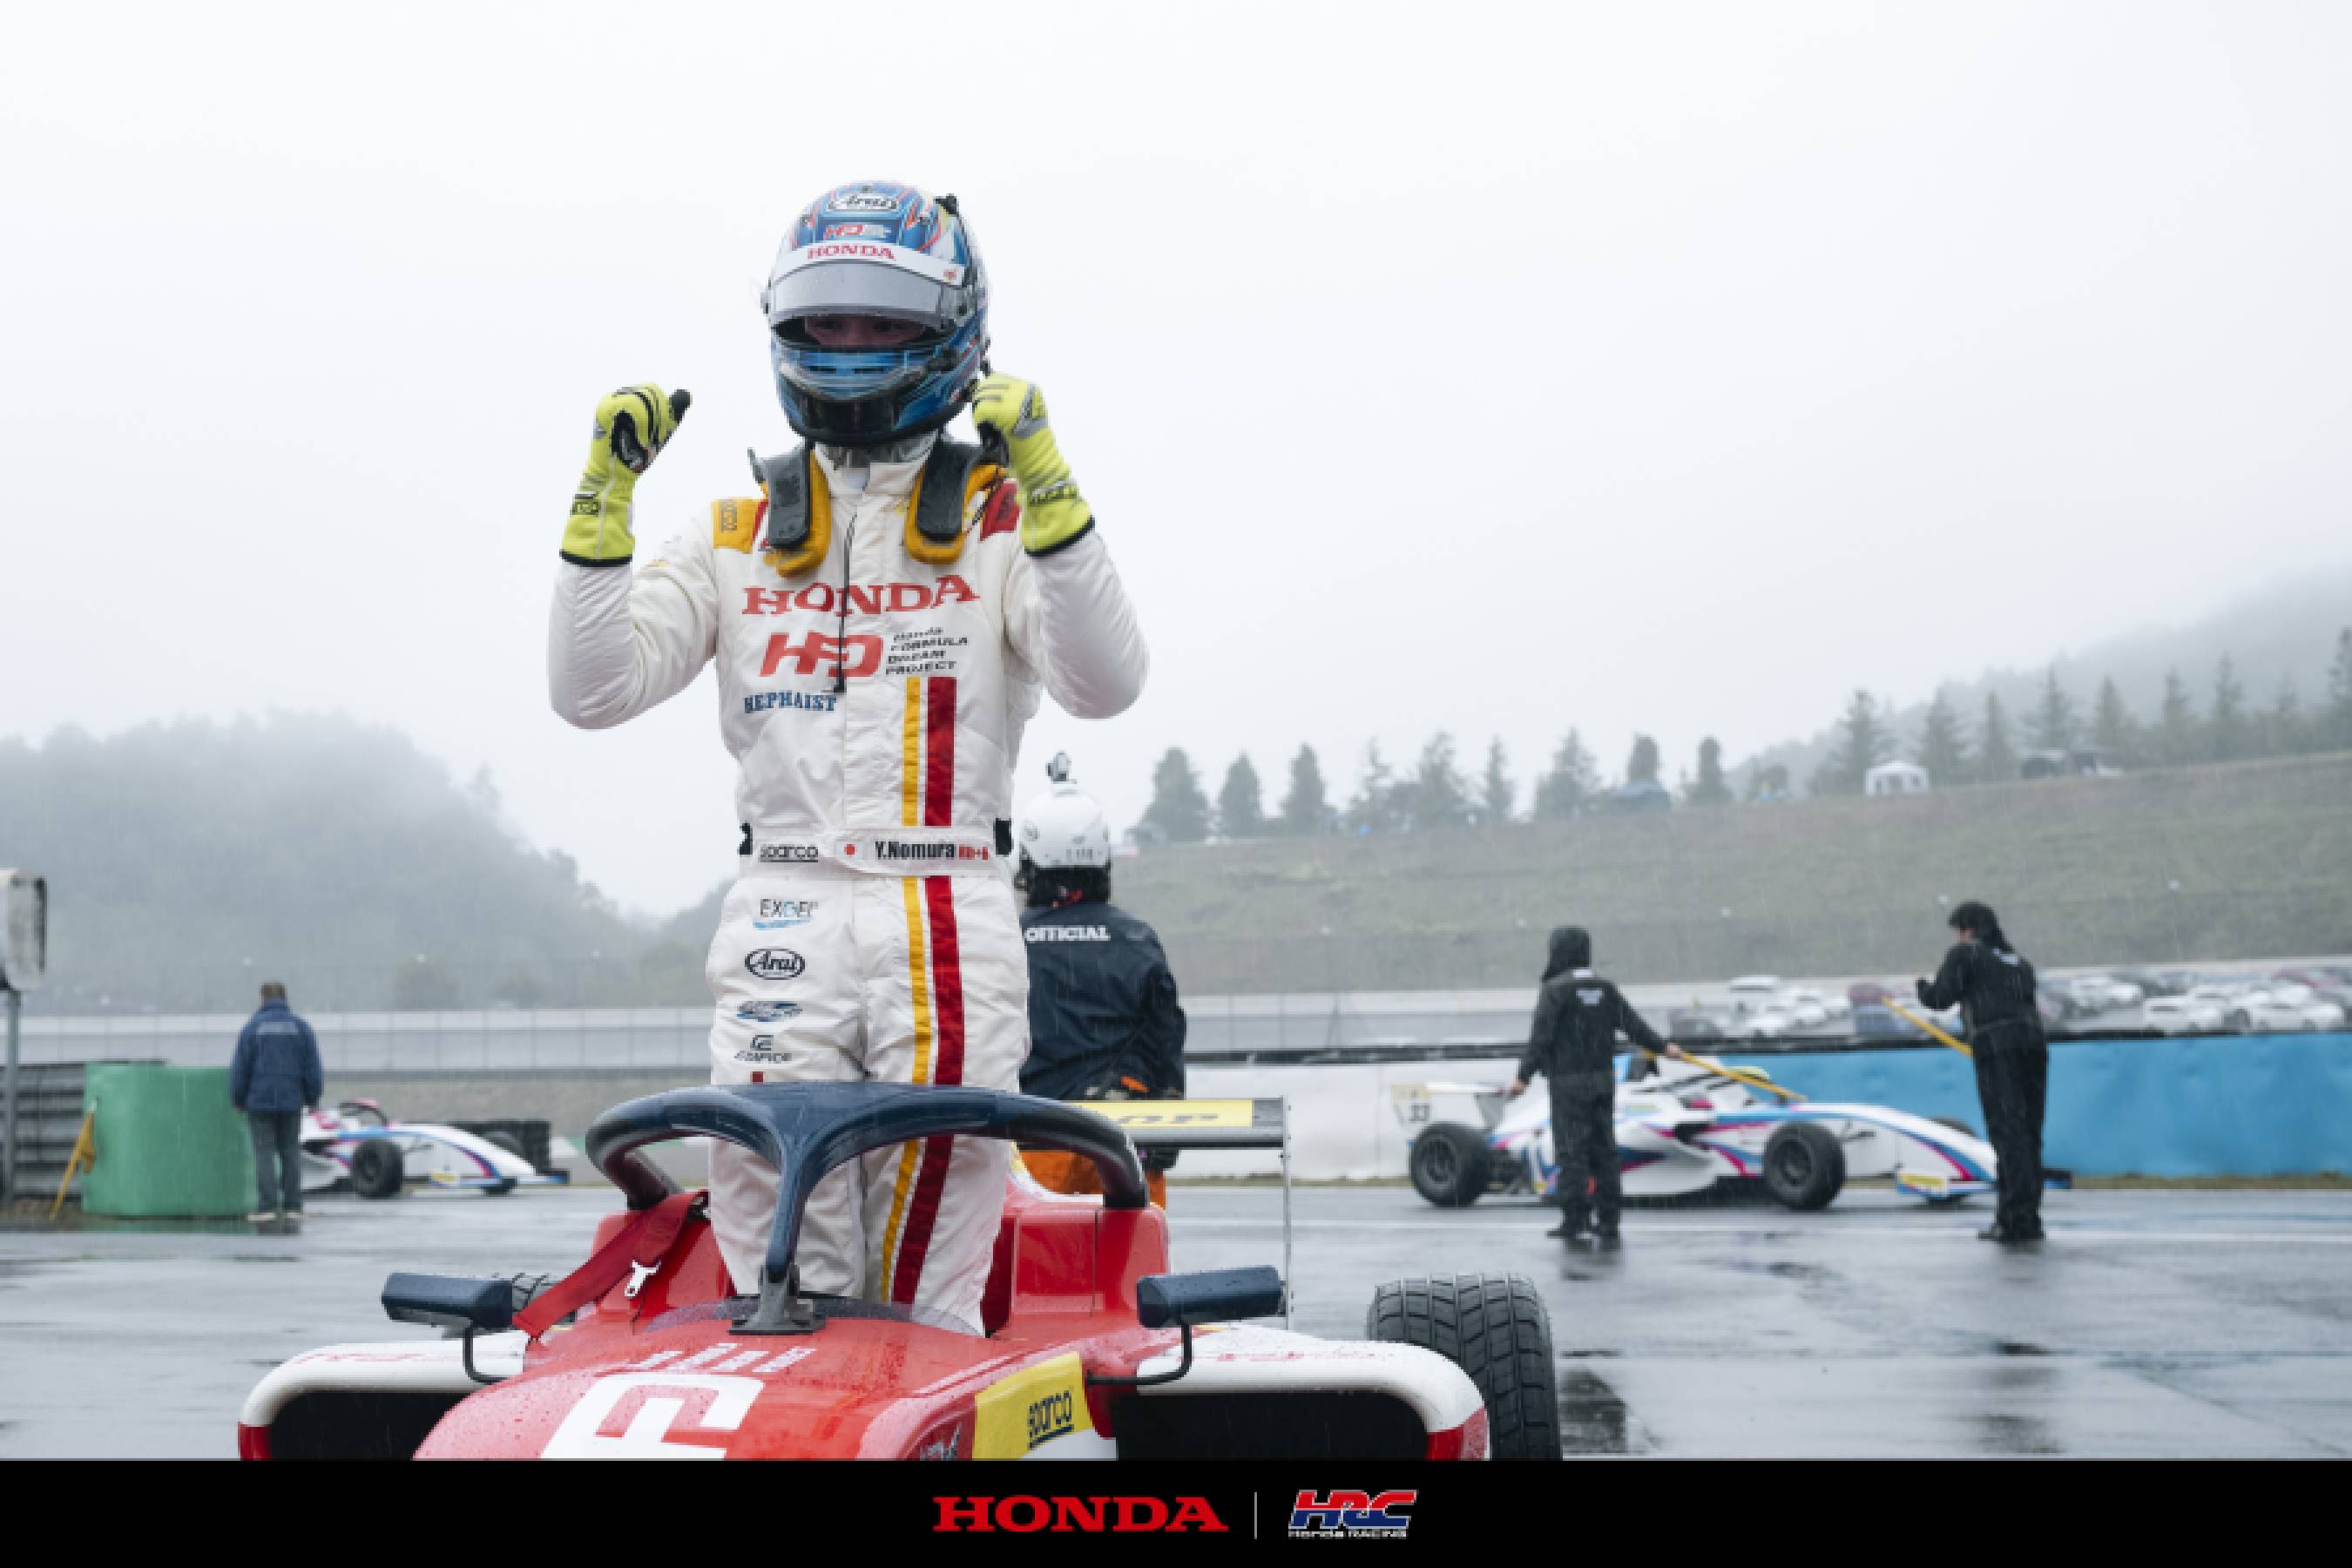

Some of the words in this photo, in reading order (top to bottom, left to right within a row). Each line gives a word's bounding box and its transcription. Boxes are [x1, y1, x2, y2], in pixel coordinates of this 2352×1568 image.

[808, 245, 896, 260] HONDA
[741, 574, 981, 617] HONDA
[885, 661, 957, 675] PROJECT
[743, 690, 837, 714] HEPHAIST
[875, 841, 956, 861] Y.Nomura
[1024, 924, 1112, 943] OFFICIAL
[1028, 1389, 1072, 1439] sparco
